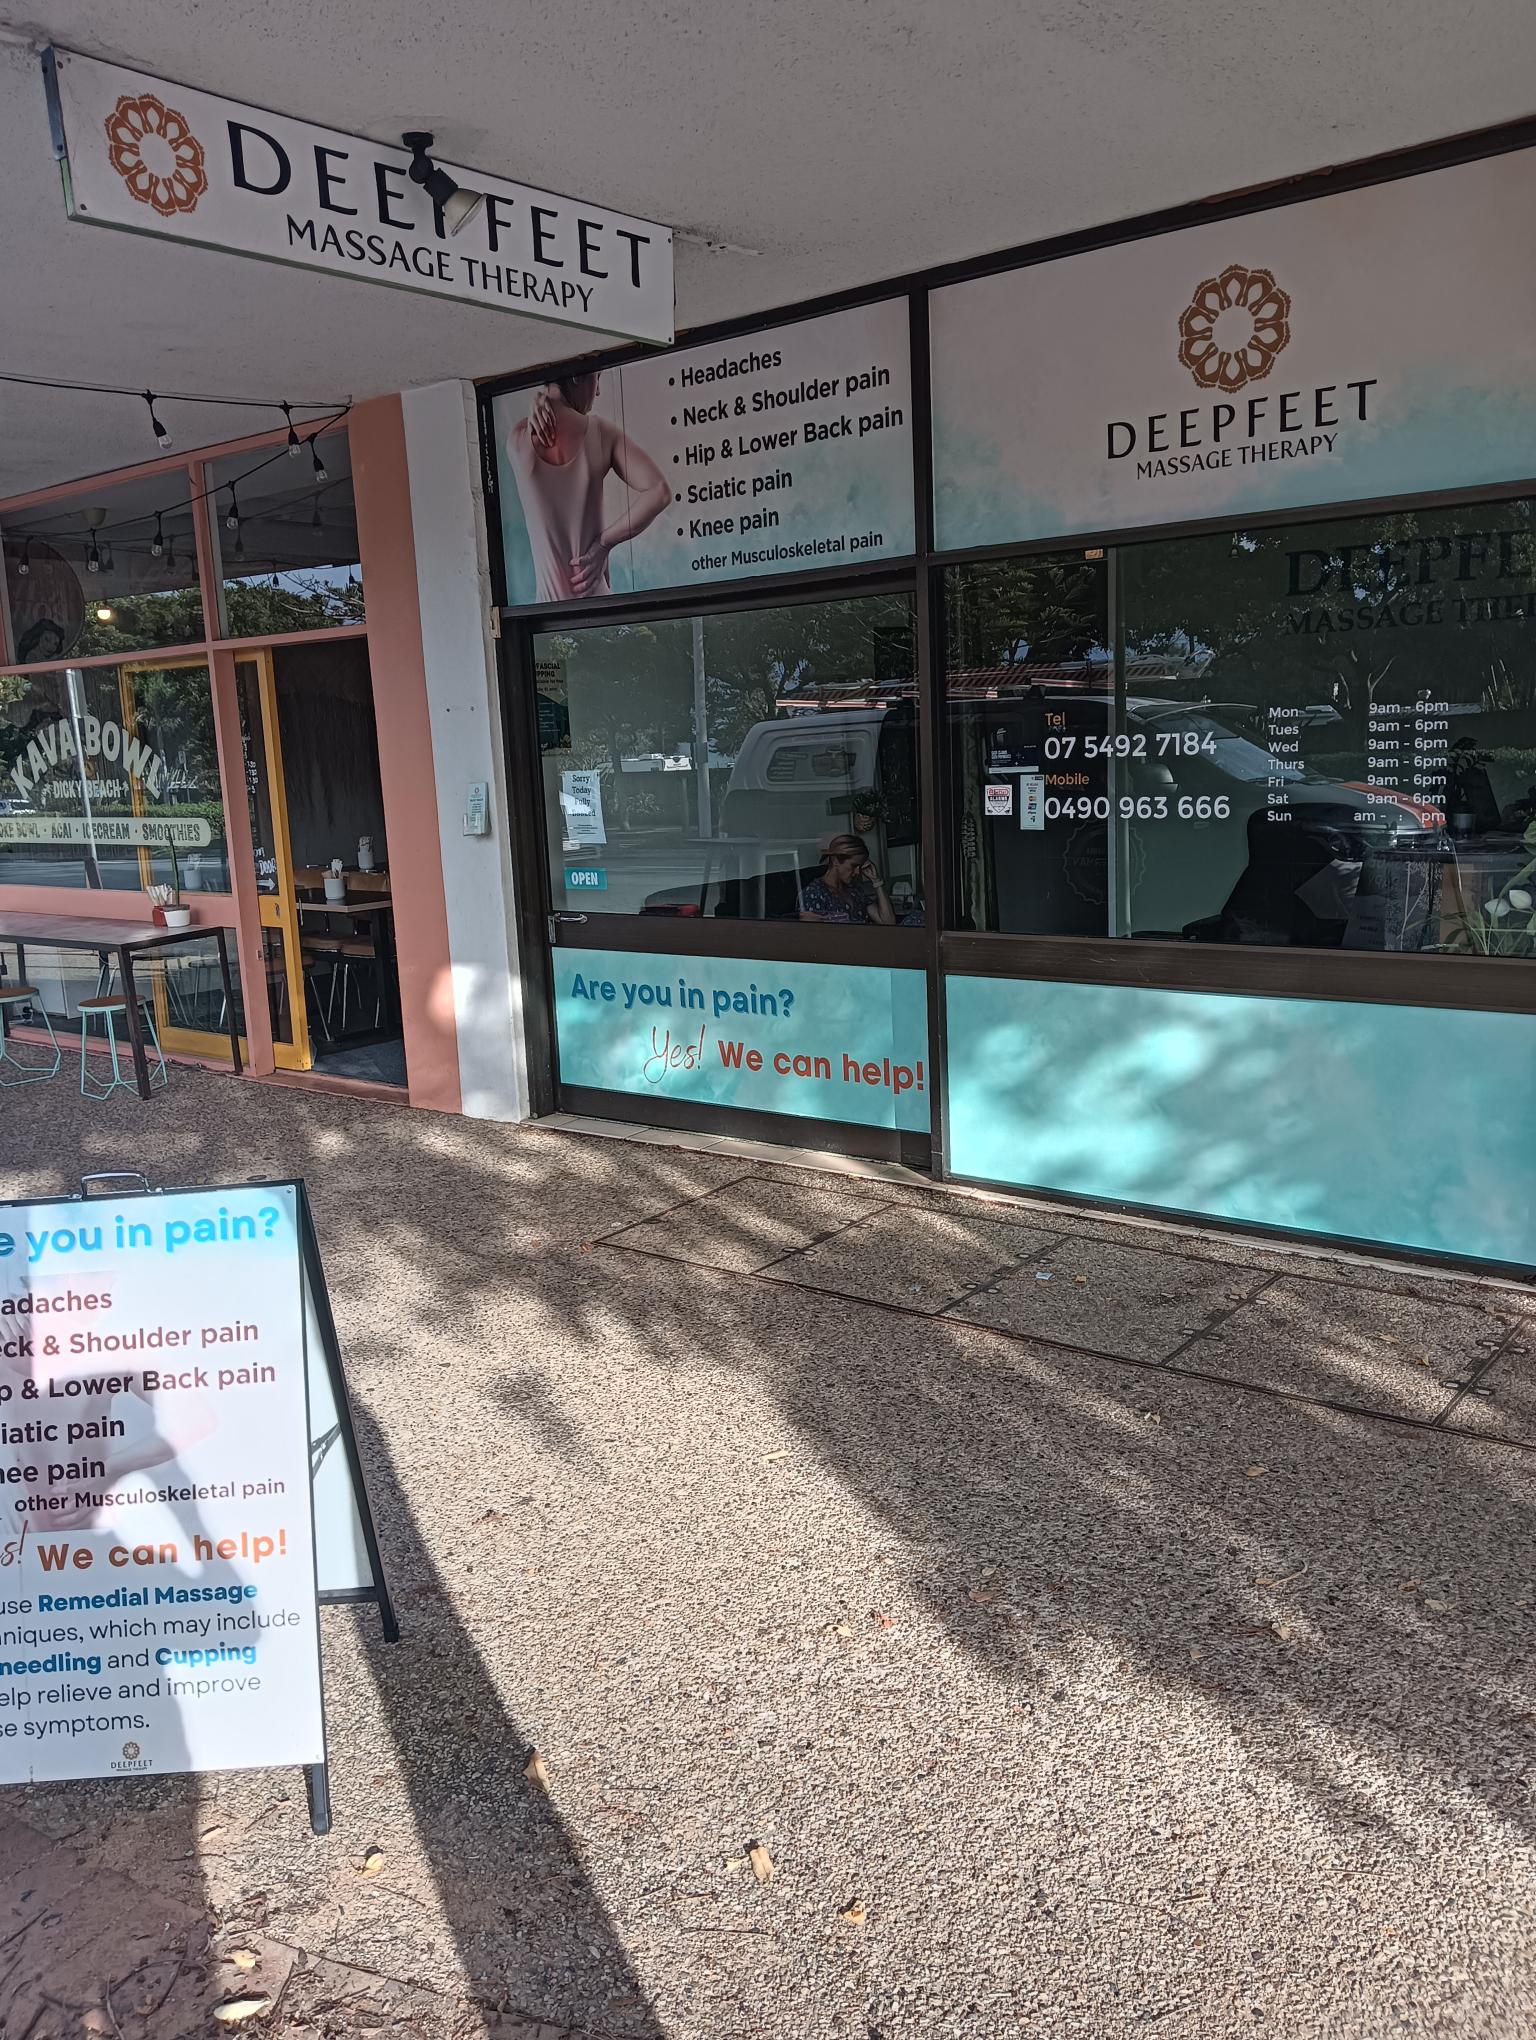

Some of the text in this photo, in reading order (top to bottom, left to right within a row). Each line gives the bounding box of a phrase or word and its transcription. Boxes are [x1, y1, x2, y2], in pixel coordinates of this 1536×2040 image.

[286, 214, 593, 312] MASSAGE THERAPY
[681, 350, 782, 387] Headaches
[683, 365, 890, 427] Neck & Shoulder pain
[1107, 379, 1378, 459] DEEPFEET
[686, 406, 903, 466] Hip & Lower Back pain
[1137, 432, 1338, 480] MASSAGE THERAPY
[687, 469, 793, 504] Sciatic pain
[690, 507, 780, 539] Knee pain
[691, 530, 883, 571] other Musculoskeletal pain
[1045, 712, 1066, 727] Tel
[1269, 707, 1299, 719] Mon
[1369, 702, 1400, 714] 9am
[1415, 700, 1449, 714] 6pm
[1268, 724, 1299, 736] Tues
[1368, 720, 1400, 732] 9am
[1415, 718, 1449, 733] 6pm
[10, 717, 77, 800] KAVA
[84, 714, 165, 800] BOWL
[1044, 731, 1217, 760] 07 5492 7184
[1268, 741, 1299, 753] Wed
[1368, 738, 1399, 750] 9am
[1414, 737, 1448, 751] 6pm
[1267, 759, 1305, 771] Thurs
[1367, 756, 1399, 768] 9am
[1413, 755, 1448, 769] 6pm
[54, 778, 121, 799] DICKY BEACH
[572, 785, 592, 796] Today
[1045, 773, 1090, 786] Mobile
[1267, 776, 1285, 788] Fri
[1367, 774, 1398, 786] 9am
[1413, 773, 1447, 787] 6pm
[1044, 795, 1231, 819] 0490 963 666
[1267, 793, 1289, 805] Sat
[1366, 793, 1398, 804] 9am
[1412, 793, 1446, 806] 6pm
[1267, 810, 1292, 822] Sun
[1353, 812, 1376, 822] am
[1421, 811, 1446, 824] pm
[51, 822, 72, 840] ACAI
[83, 822, 130, 841] ICECREAM
[142, 823, 201, 842] SMOOTHIES
[571, 871, 599, 887] OPEN
[571, 973, 795, 1018] Are you in pain?
[643, 1023, 925, 1095] Yes! We can help!
[25, 1225, 102, 1265] you
[115, 1214, 152, 1249] in
[164, 1206, 281, 1254] pain?
[42, 1335, 61, 1356] &
[69, 1326, 192, 1355] Shoulder
[200, 1320, 259, 1348] pain
[21, 1378, 40, 1400] &
[48, 1373, 134, 1399] Lower
[142, 1366, 208, 1392] Back
[218, 1361, 277, 1390] pain
[1, 1415, 126, 1445] iatic pain
[47, 1457, 106, 1486] pain
[14, 1478, 286, 1513] other Musculoskeletal pain
[37, 1543, 94, 1572] We
[108, 1542, 178, 1568] can
[193, 1528, 288, 1564] help!
[38, 1587, 149, 1613] Remedial
[154, 1584, 258, 1606] Massage
[89, 1617, 157, 1641] which
[163, 1617, 211, 1638] may
[217, 1608, 301, 1632] include
[107, 1648, 150, 1669] and
[155, 1641, 257, 1668] Cupping
[38, 1683, 112, 1705] relieve
[118, 1678, 161, 1699] and
[167, 1676, 262, 1698] improve
[24, 1713, 151, 1740] symptoms.
[110, 1759, 153, 1769] DEEPFEET
